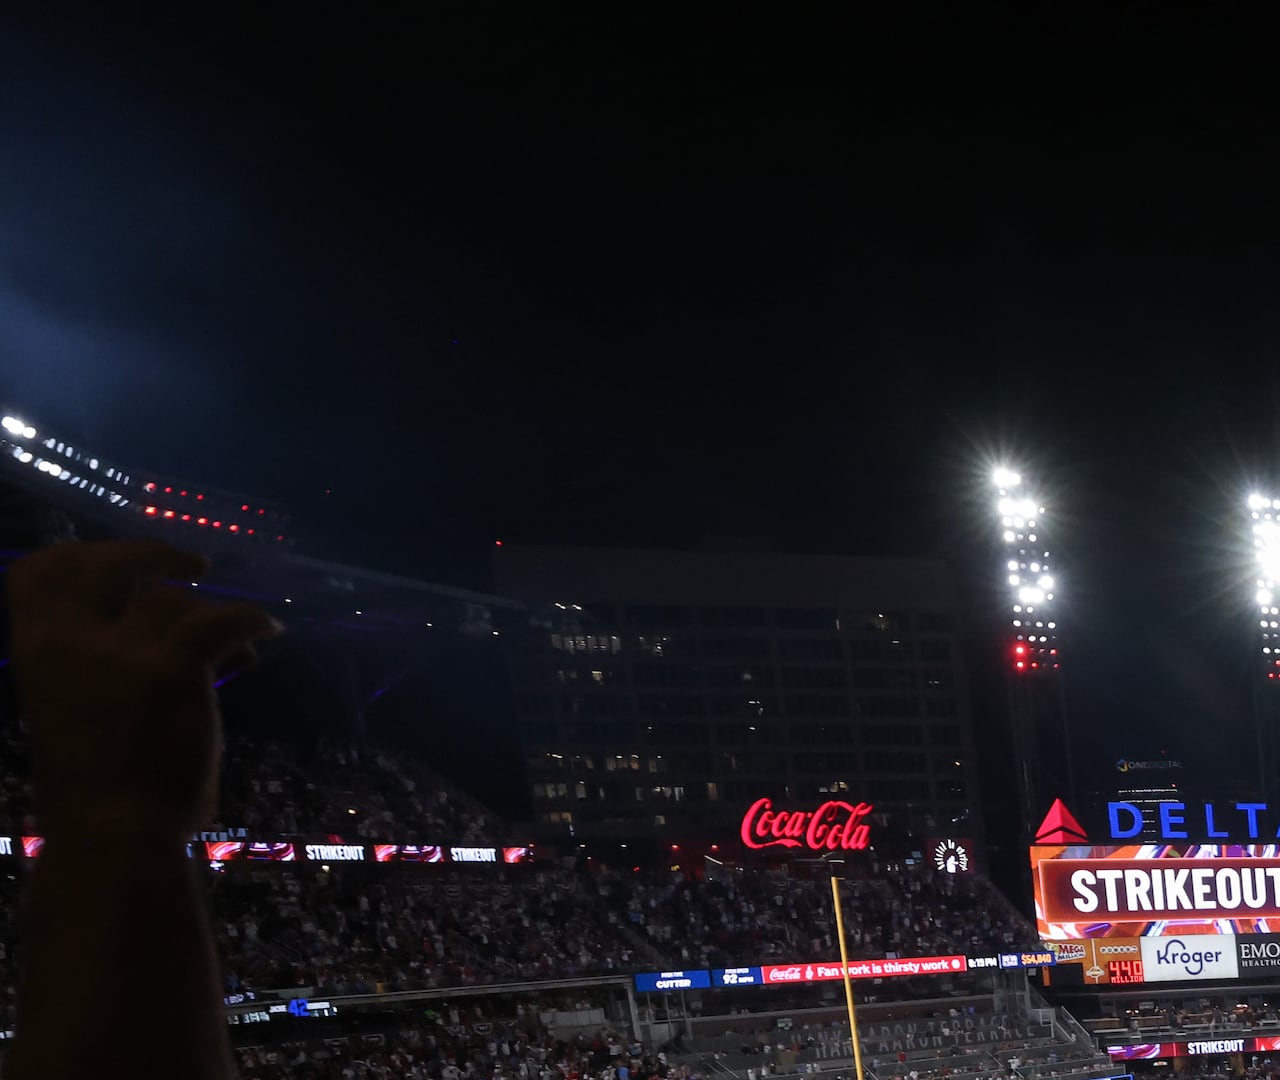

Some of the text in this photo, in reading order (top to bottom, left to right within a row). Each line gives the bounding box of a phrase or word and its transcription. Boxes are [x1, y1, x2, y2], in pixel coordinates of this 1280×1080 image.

[741, 797, 875, 851] Coca-Cola
[305, 844, 365, 861] STRIKEOUT
[451, 847, 496, 862] STRIKEOUT
[1157, 939, 1223, 975] Kroger
[769, 968, 801, 981] Coca-Cola
[817, 966, 839, 977] Fan
[872, 963, 882, 974] is
[883, 960, 920, 974] thirsty
[920, 959, 950, 972] work
[1109, 961, 1143, 976] 440
[656, 979, 692, 989] CUTTER
[723, 974, 738, 984] 92
[1110, 975, 1144, 983] MILLION
[287, 997, 310, 1017] 42
[1187, 1039, 1245, 1055] STRIKEOUT
